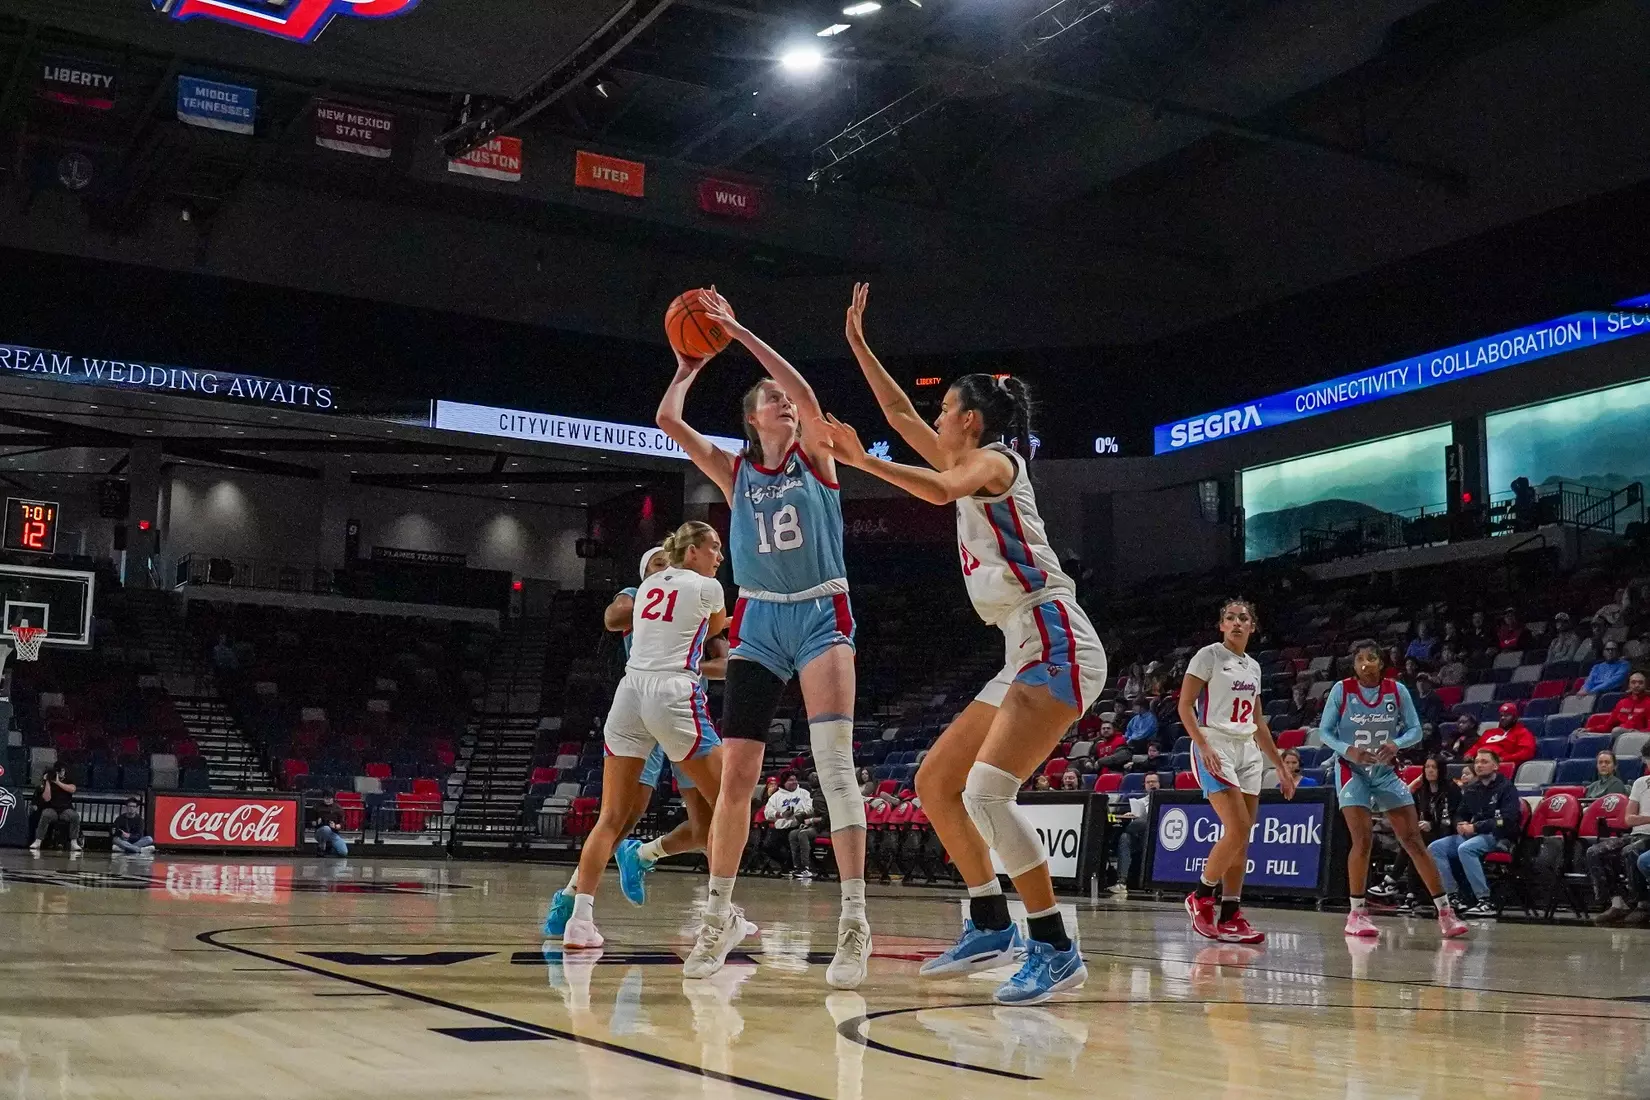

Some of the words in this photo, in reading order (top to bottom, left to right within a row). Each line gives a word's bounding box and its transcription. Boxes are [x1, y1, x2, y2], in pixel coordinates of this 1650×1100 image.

[44, 65, 114, 89] LIBERTY
[195, 86, 239, 104] MIDDLE
[182, 97, 251, 119] TENNESSEE
[317, 107, 346, 123] NEW
[347, 114, 392, 132] MEXICO
[335, 124, 373, 140] STATE
[481, 140, 503, 154] AM
[461, 150, 519, 169] OUSTON
[592, 165, 630, 184] UTEP
[715, 191, 747, 208] WKU
[82, 357, 220, 395] WEDDING
[228, 377, 339, 410] AWAITS.
[915, 377, 942, 386] LIBERTY
[1170, 404, 1263, 447] SEGRA
[1295, 367, 1409, 413] CONNECTIVITY
[1430, 321, 1582, 378] COLLABORATION
[1607, 309, 1650, 333] SEC
[1095, 436, 1119, 454] 0%
[22, 505, 52, 521] 7:01
[23, 521, 46, 548] 12
[754, 503, 804, 554] 18
[641, 587, 679, 623] 21
[1231, 680, 1257, 697] Liberty
[1230, 697, 1253, 723] 12
[169, 802, 285, 843] Coca-Cola
[1193, 816, 1260, 844] Car
[1263, 815, 1322, 846] Bank
[1265, 859, 1300, 876] FULL
